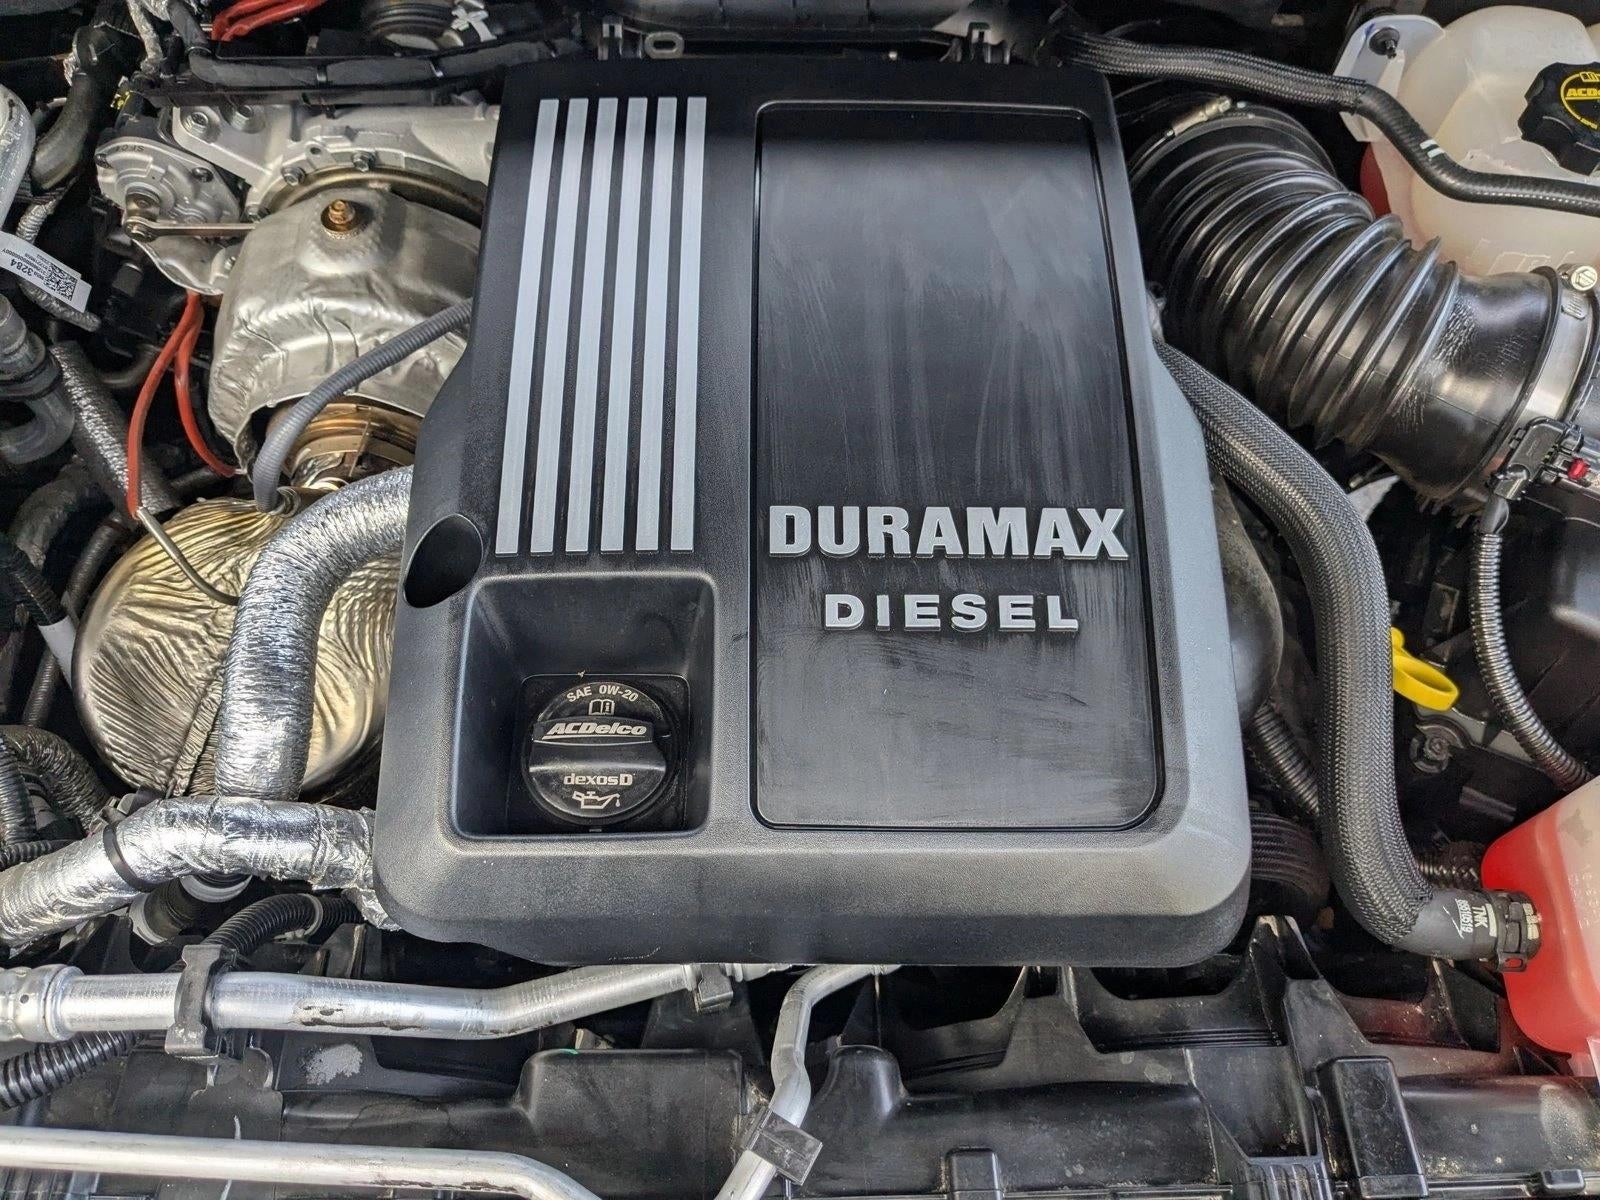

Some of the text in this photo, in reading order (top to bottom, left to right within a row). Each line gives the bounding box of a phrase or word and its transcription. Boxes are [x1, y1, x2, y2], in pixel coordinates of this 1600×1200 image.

[1566, 88, 1600, 97] ACD
[10, 258, 34, 277] 3284
[769, 505, 1129, 560] DURAMAX
[825, 593, 1079, 632] DIESEL
[566, 684, 639, 703] SAE 0W-20
[546, 722, 648, 736] ACDelco
[563, 772, 634, 786] dexosD
[1472, 905, 1489, 929] TNK
